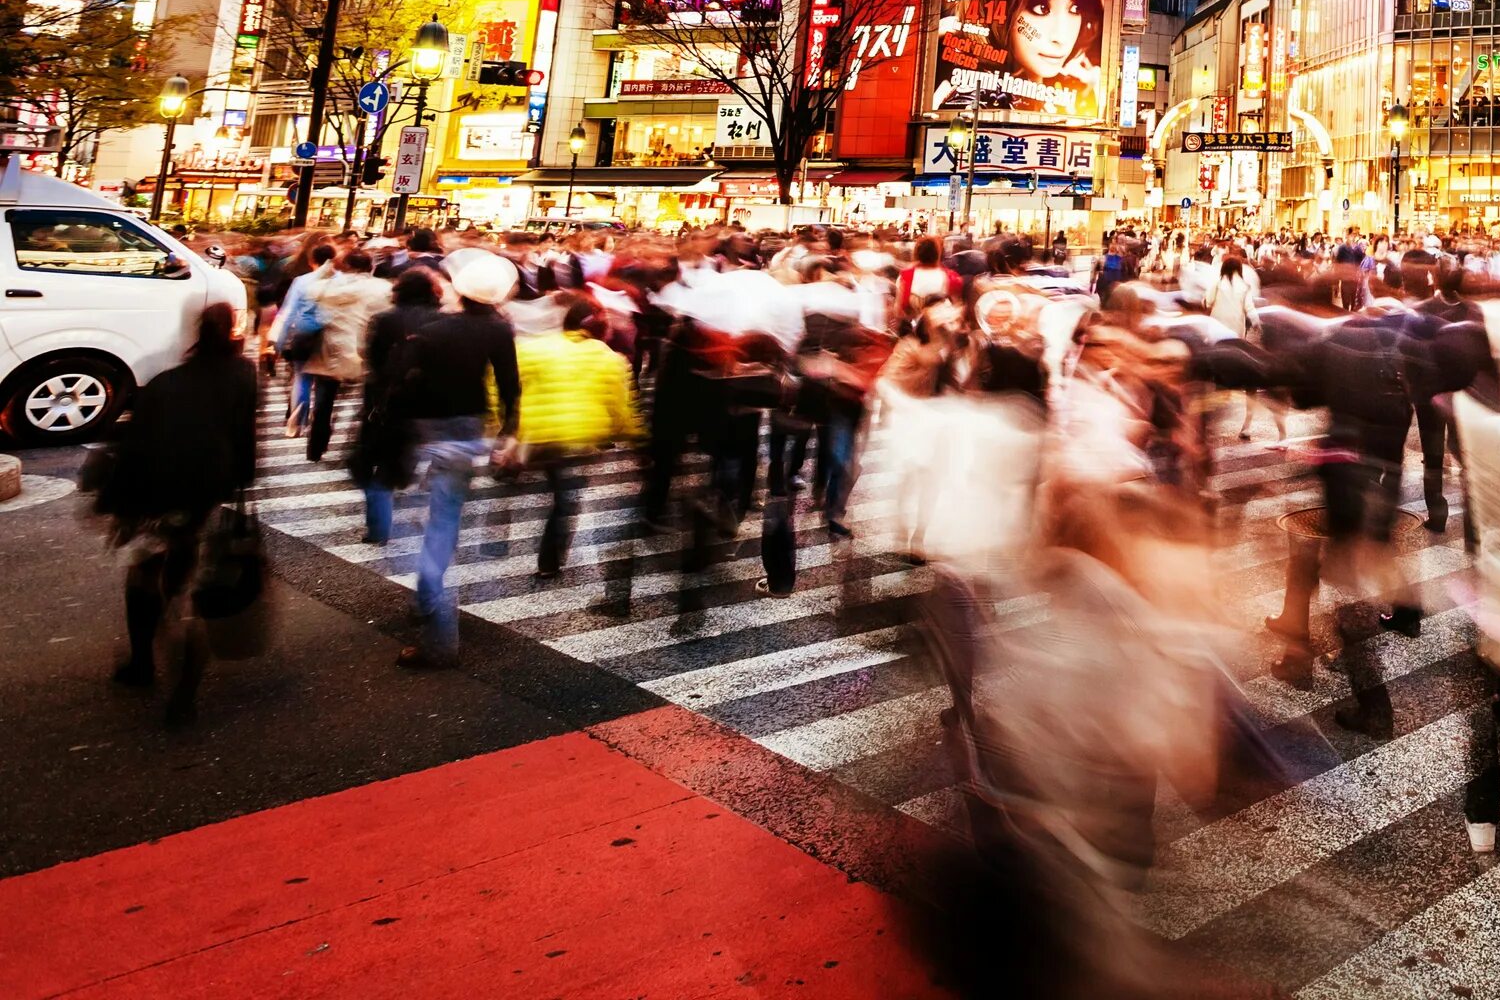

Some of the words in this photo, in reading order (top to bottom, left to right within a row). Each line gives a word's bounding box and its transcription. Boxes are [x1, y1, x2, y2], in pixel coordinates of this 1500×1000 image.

[719, 107, 744, 118] うなぎ
[1203, 133, 1291, 145] 歩きタバコ禁止
[397, 133, 417, 187] 道玄坂
